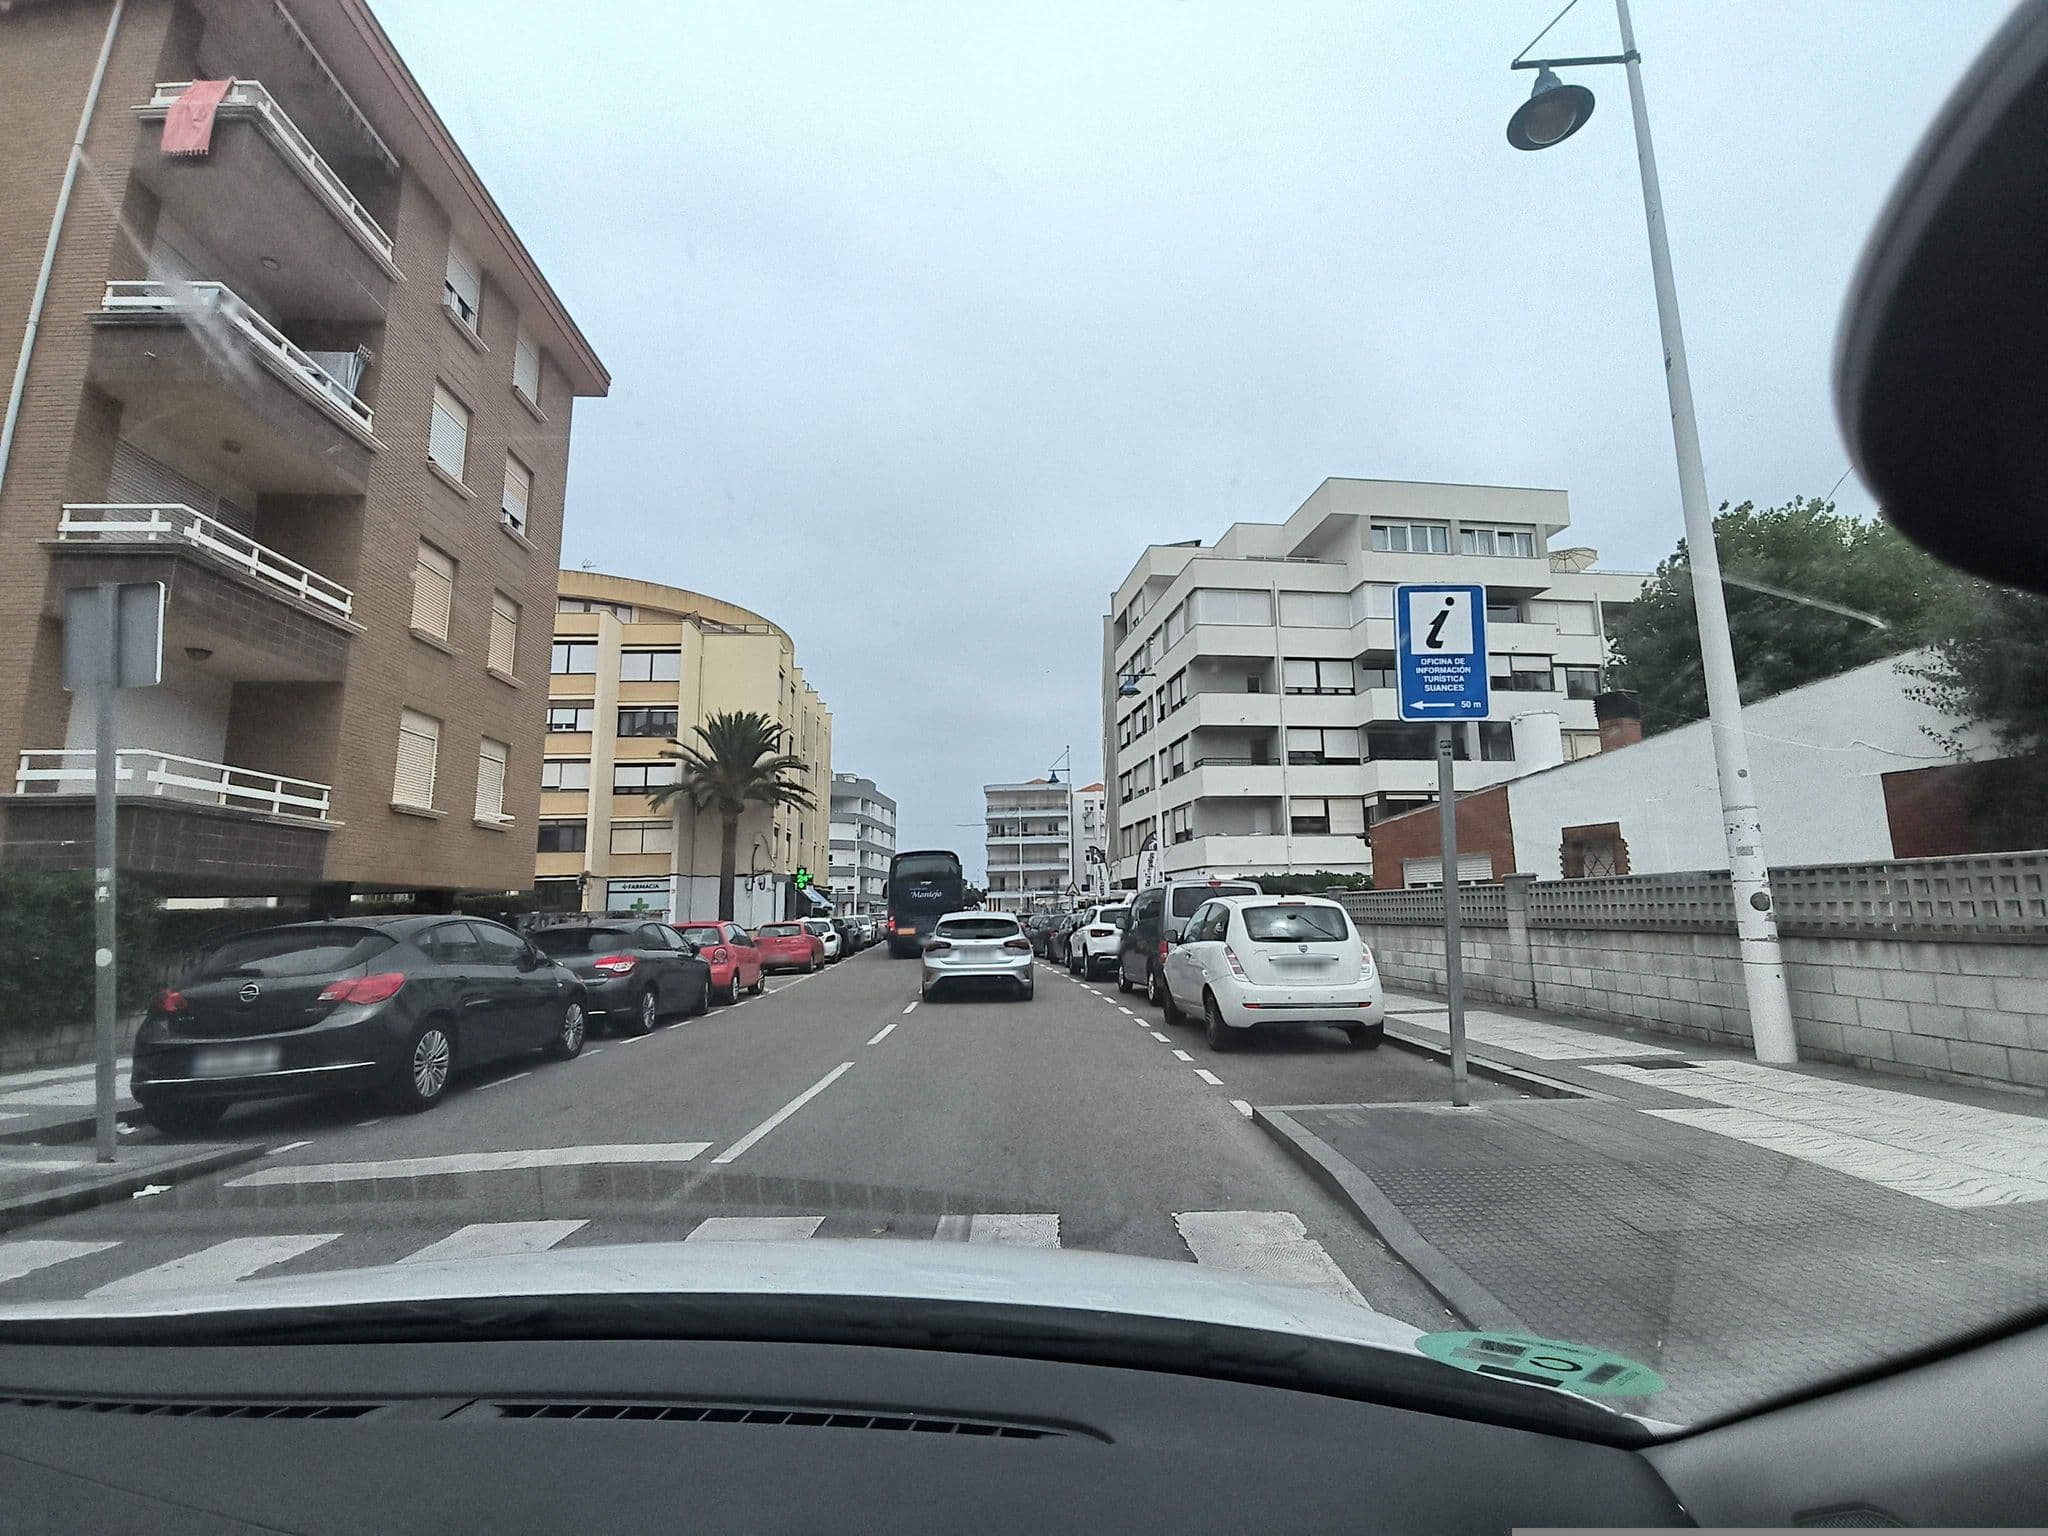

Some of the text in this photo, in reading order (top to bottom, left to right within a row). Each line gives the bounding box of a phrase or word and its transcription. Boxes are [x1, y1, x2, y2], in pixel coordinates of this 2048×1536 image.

[1416, 665, 1471, 674] INFORMACIÓN
[1423, 674, 1465, 682] TURÍSTICA
[1424, 684, 1465, 692] SUANCES
[1461, 701, 1472, 709] 50
